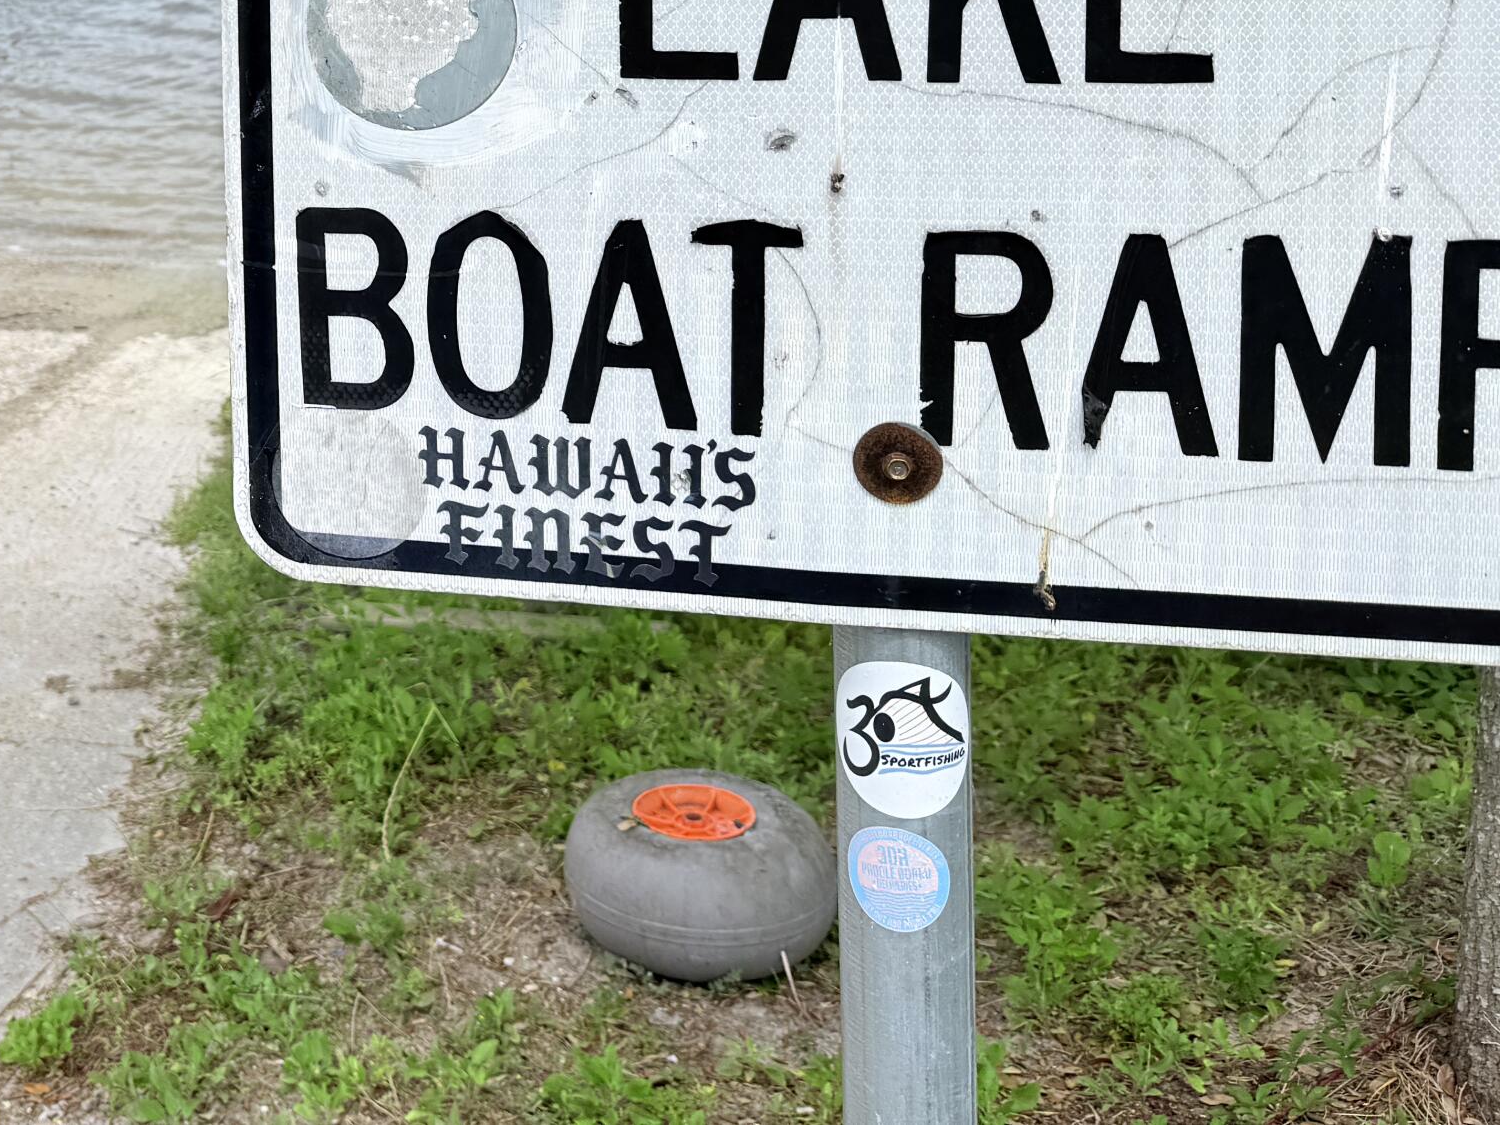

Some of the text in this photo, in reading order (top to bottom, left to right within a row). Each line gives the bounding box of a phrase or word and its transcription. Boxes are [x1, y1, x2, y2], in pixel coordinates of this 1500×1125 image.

[295, 206, 803, 437] BOAT
[437, 500, 732, 587] FINEST
[880, 746, 966, 769] SPORTFISHING
